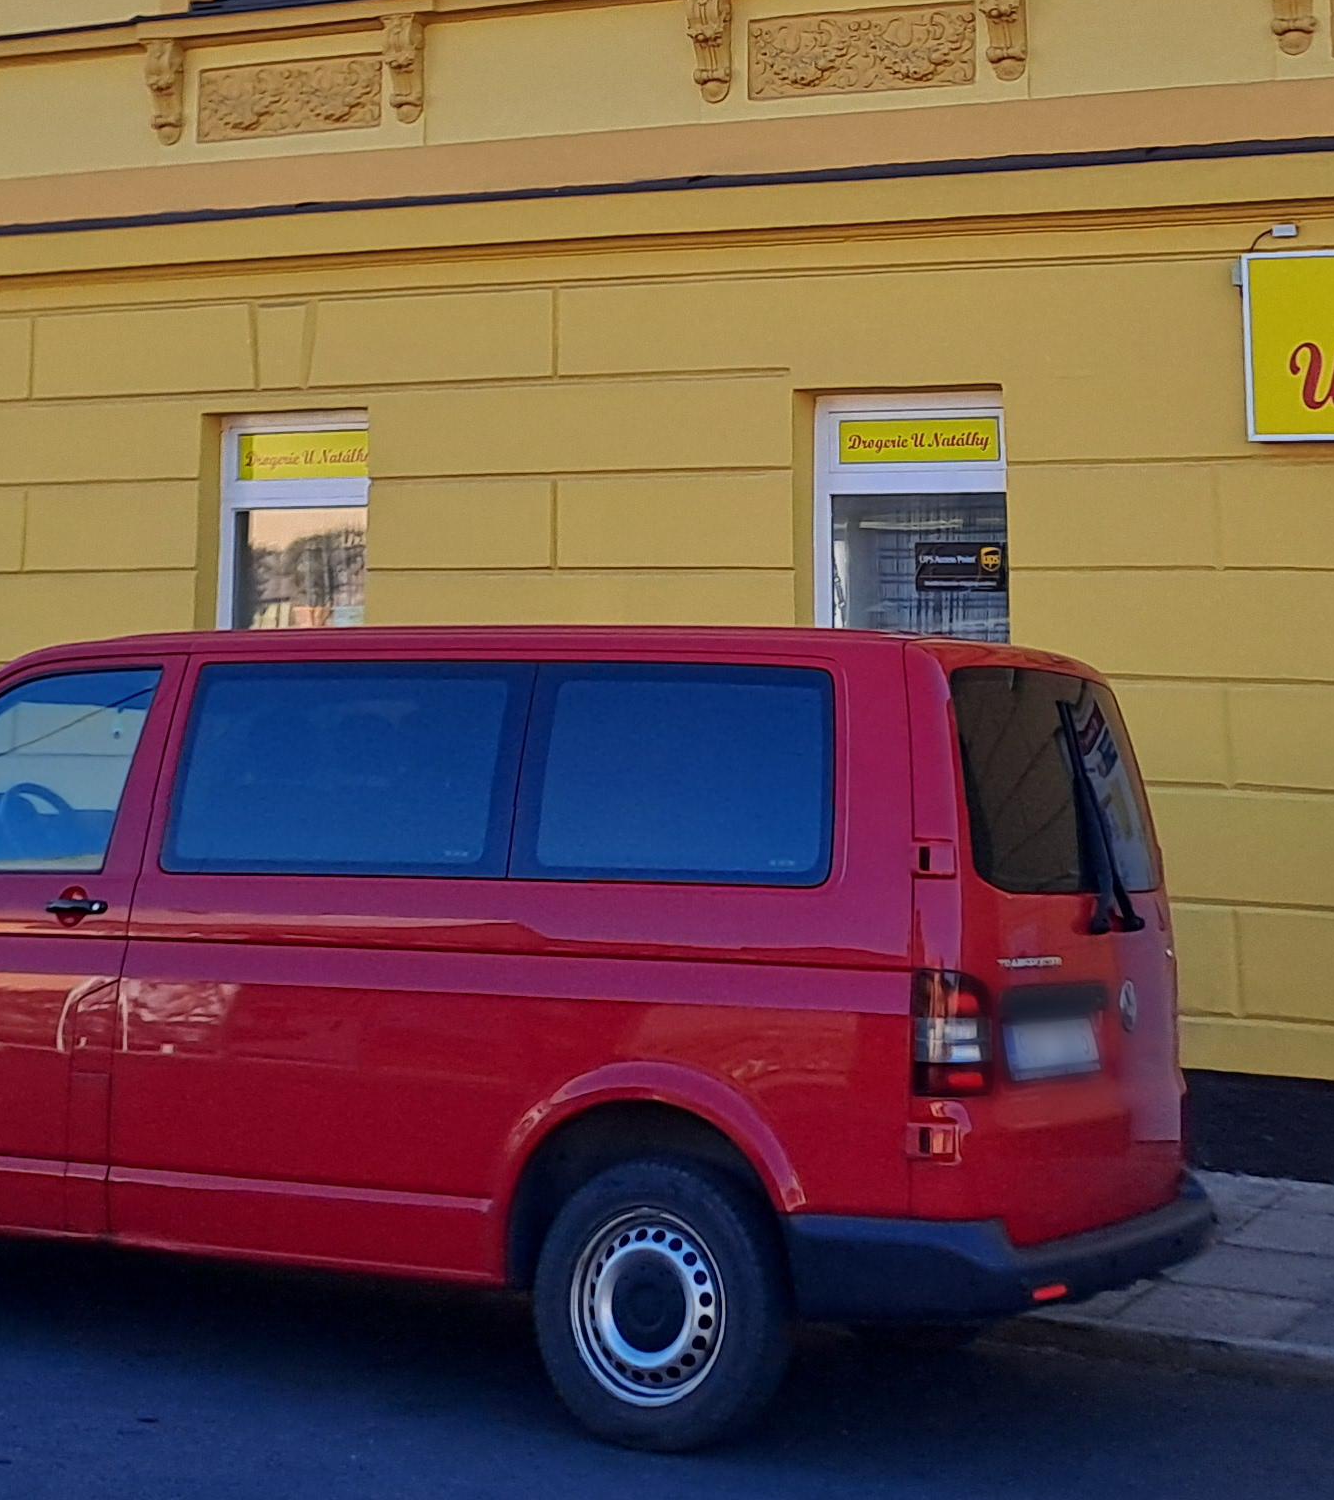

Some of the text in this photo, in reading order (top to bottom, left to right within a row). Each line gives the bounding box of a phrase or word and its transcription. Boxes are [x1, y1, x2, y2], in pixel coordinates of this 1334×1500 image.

[848, 432, 989, 453] Drogerie U Natálky
[302, 450, 314, 464] U
